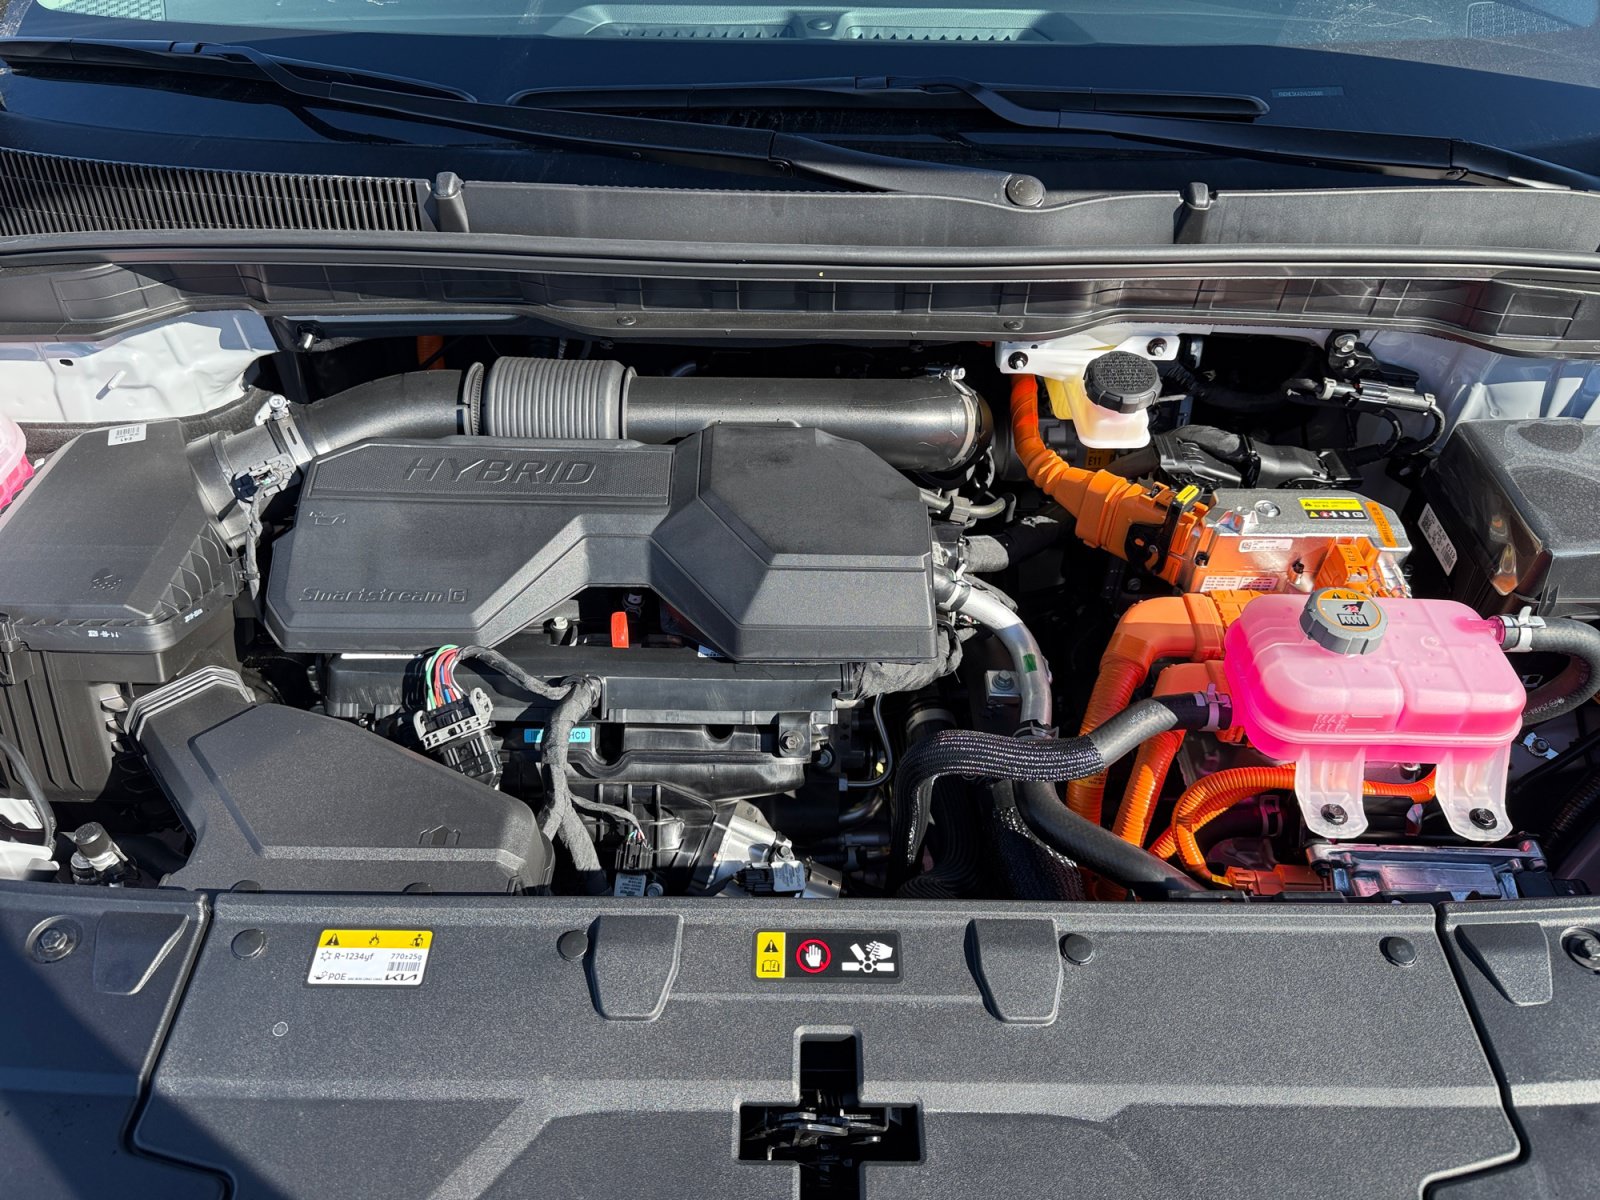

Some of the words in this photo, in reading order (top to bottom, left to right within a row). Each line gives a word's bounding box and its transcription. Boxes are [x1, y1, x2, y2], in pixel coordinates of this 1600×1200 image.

[402, 457, 597, 485] HYBRID
[298, 587, 444, 602] Smartstream
[334, 952, 375, 962] R-1234yf
[328, 972, 347, 981] POE
